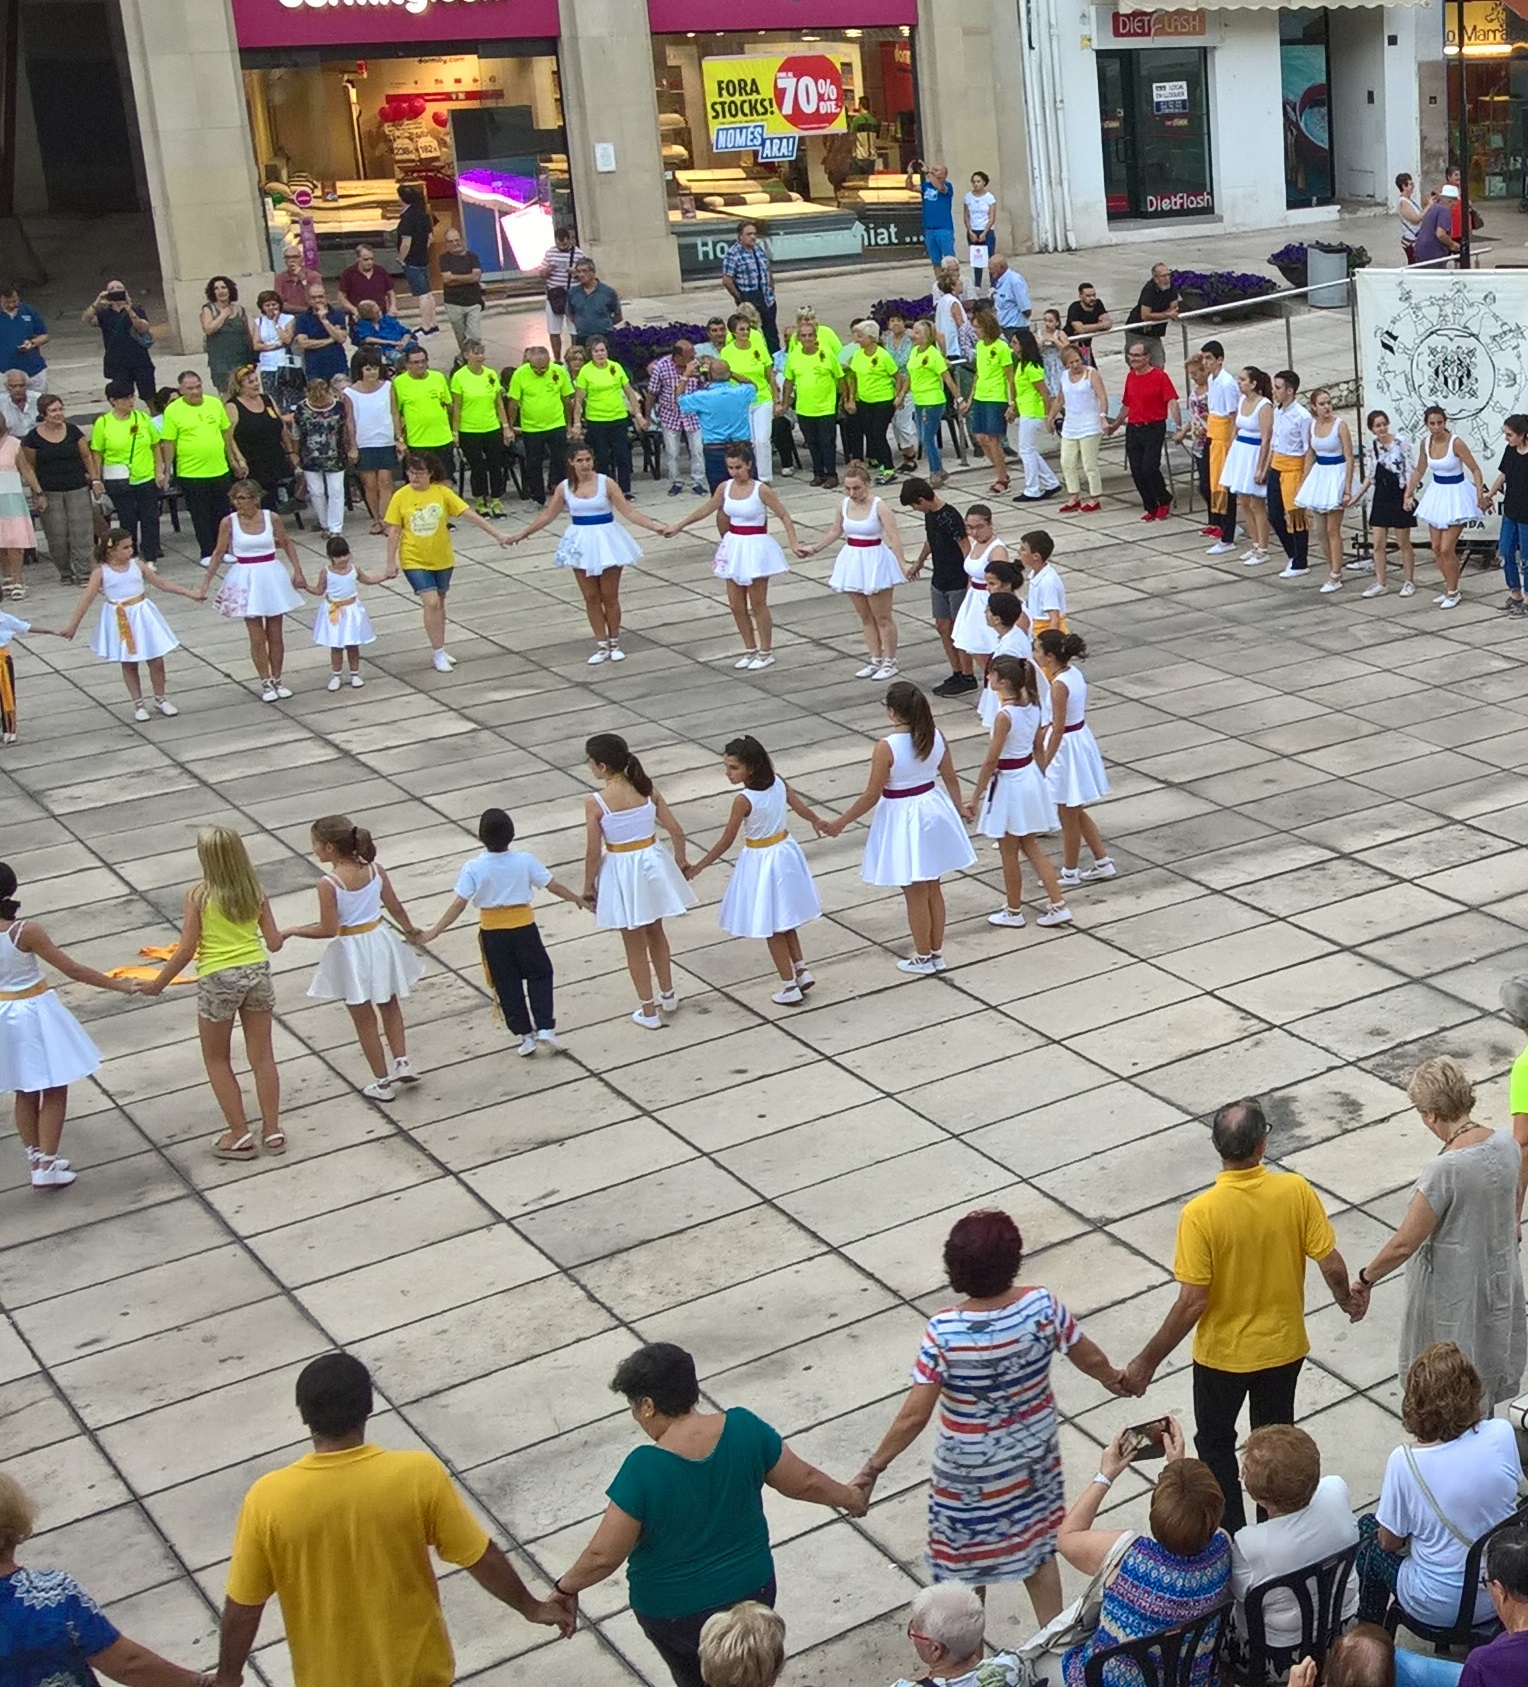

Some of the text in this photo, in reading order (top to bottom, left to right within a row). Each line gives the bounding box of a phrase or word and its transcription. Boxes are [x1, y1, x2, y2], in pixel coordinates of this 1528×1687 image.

[717, 78, 761, 99] FORA
[710, 97, 776, 120] STOCKS!
[717, 124, 763, 149] NOMÉS
[762, 137, 793, 158] ARA!
